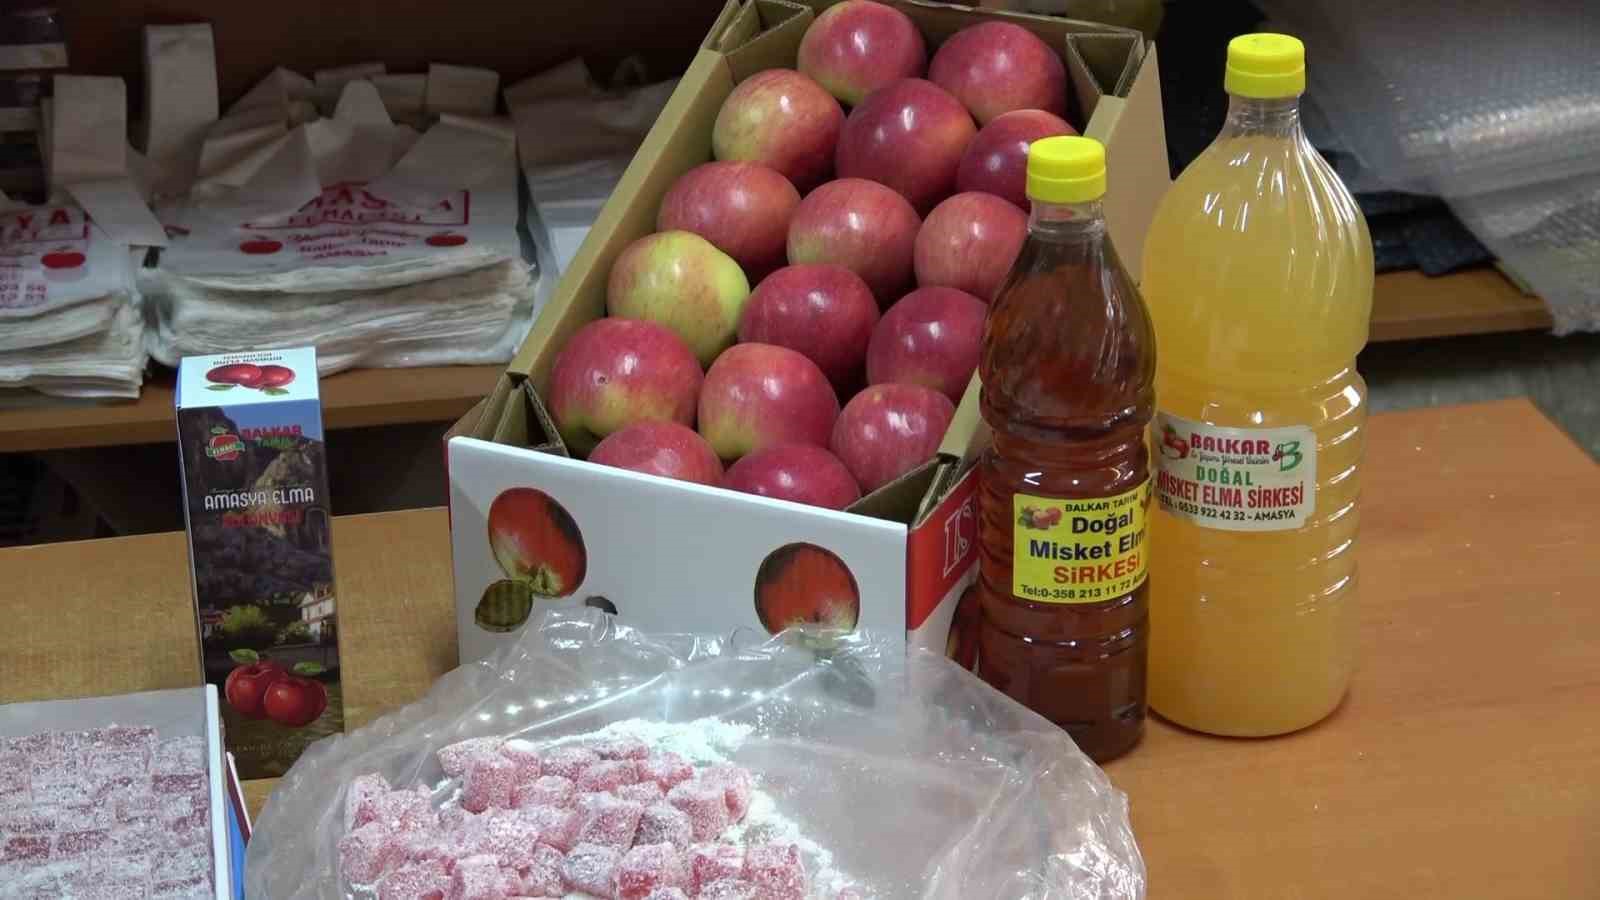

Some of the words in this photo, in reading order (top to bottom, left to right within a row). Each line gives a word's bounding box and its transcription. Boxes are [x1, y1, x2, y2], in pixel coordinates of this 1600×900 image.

[1191, 433, 1270, 455] BALKAR
[1196, 465, 1254, 486] DOĞAL
[204, 492, 266, 511] AMASYA
[272, 487, 315, 505] ELMA
[1203, 485, 1242, 508] ELMA
[1247, 481, 1304, 509] SİRKESİ
[1065, 502, 1110, 512] BALKAR
[1200, 507, 1217, 518] 922
[1220, 509, 1231, 520] 42
[1233, 510, 1245, 521] 32
[1254, 509, 1295, 521] AMASYA
[1072, 508, 1133, 535] Doğal
[1030, 538, 1112, 561] Misket
[1079, 588, 1101, 598] 213
